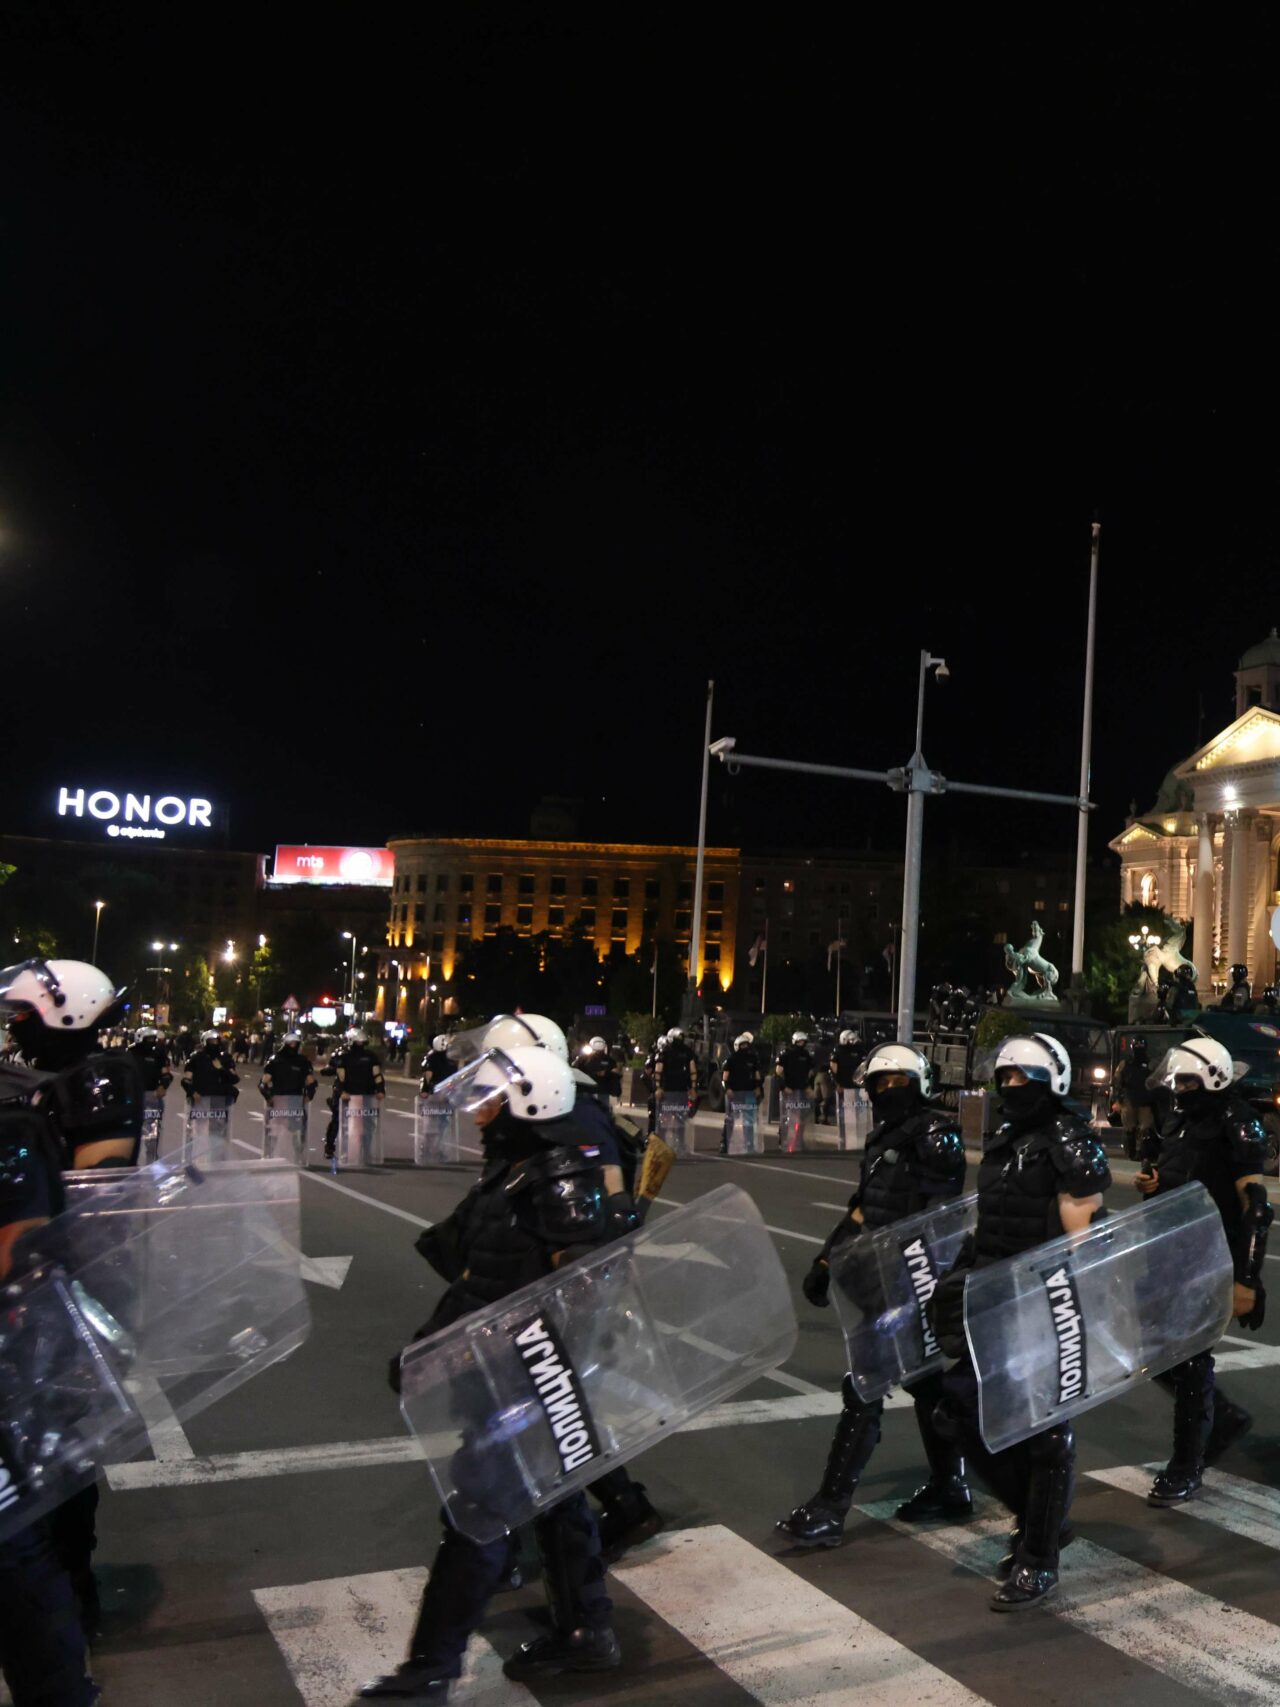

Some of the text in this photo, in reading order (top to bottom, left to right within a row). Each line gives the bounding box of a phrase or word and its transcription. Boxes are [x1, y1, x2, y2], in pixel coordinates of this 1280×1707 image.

[58, 787, 212, 827] HONOR
[297, 855, 324, 868] mts
[190, 1111, 227, 1119] POLICIJA
[269, 1109, 305, 1118] ПОЛИЦИЈА
[1046, 1267, 1082, 1402] ПОЛИЦИЈА
[515, 1317, 595, 1472] ПОЛИЦИЈА
